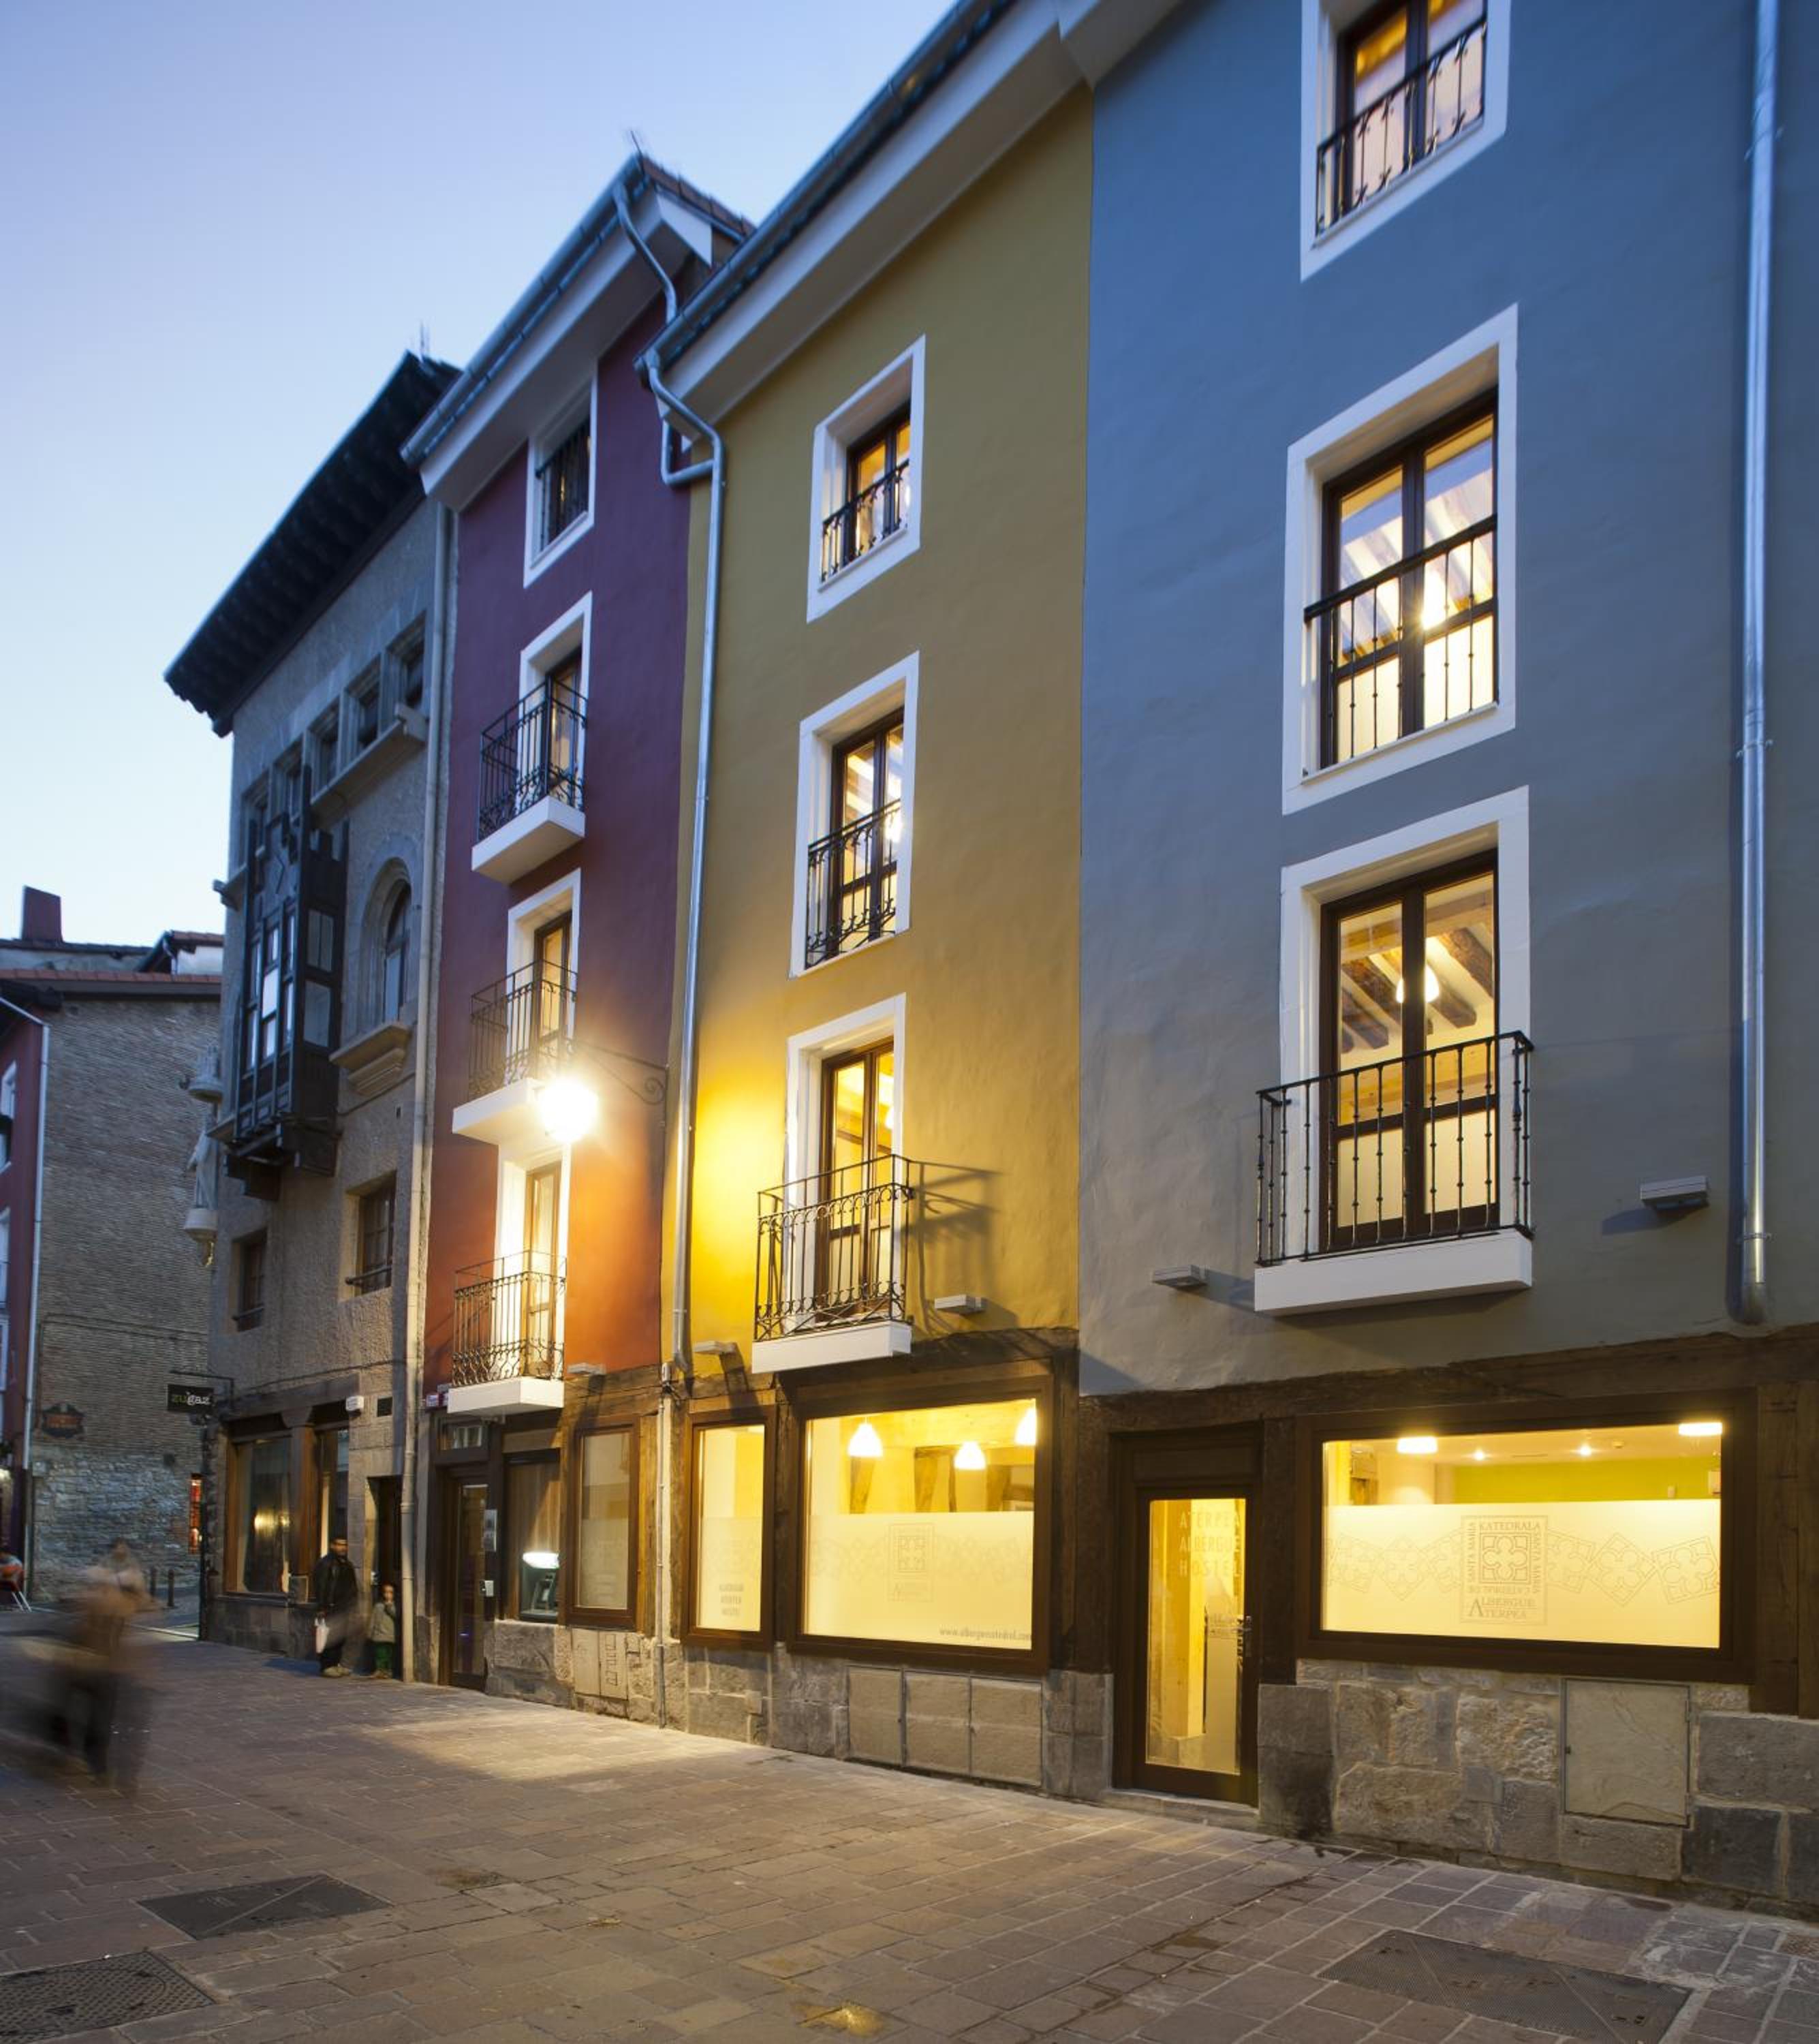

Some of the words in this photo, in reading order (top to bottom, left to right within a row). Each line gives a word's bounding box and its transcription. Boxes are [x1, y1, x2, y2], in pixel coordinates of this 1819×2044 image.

[1179, 1511, 1241, 1529] ATERPEA
[1480, 1521, 1540, 1531] KATEDRALA
[1179, 1536, 1241, 1553] ALBERGUE
[1179, 1558, 1241, 1578] HOSTEL
